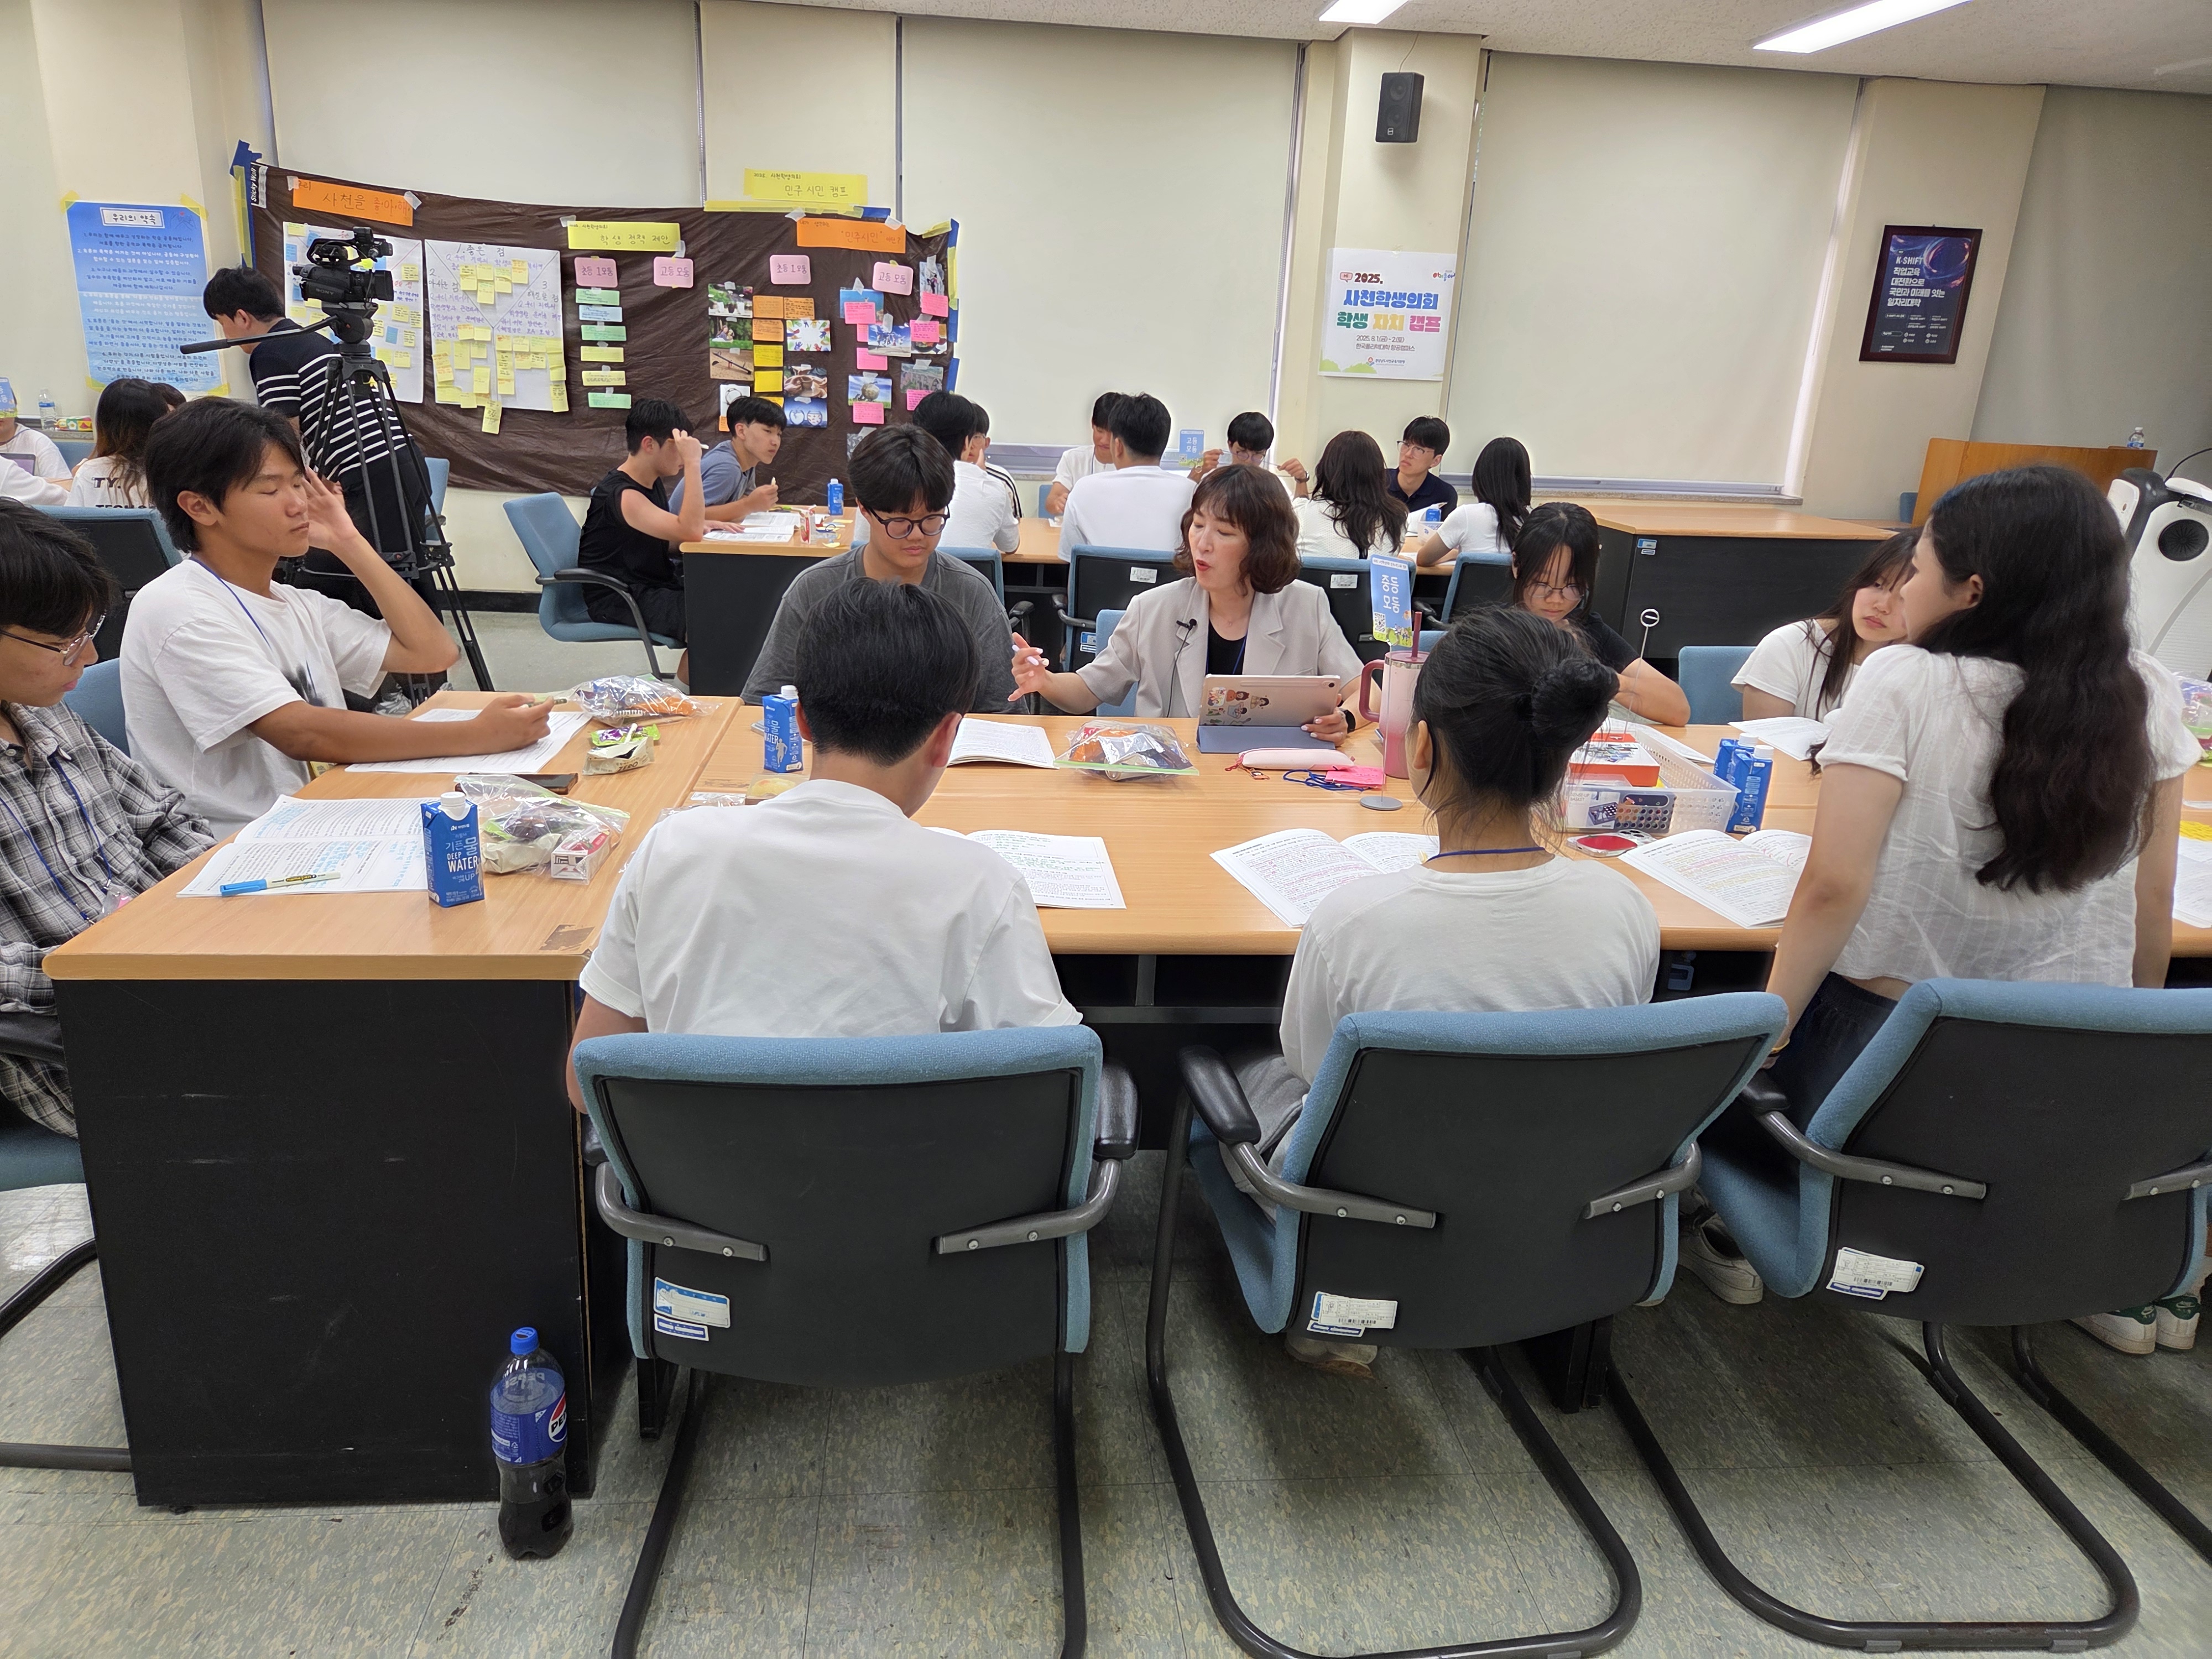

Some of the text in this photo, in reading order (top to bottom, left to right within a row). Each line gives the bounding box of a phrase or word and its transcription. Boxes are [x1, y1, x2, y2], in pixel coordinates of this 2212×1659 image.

[785, 185, 849, 197] 민주 시민 캠프
[322, 193, 366, 210] 사천을
[113, 213, 156, 225] 우리의 약속
[600, 234, 670, 246] 학생 정책 제안
[466, 245, 486, 256] 좋은
[497, 248, 505, 257] 점
[581, 266, 593, 276] 초등
[660, 266, 690, 278] 고등 모둠
[777, 263, 789, 274] 초등
[1893, 267, 1921, 276] 직업교육
[878, 272, 907, 284] 고등 모둠
[1354, 273, 1384, 284] 2025.
[1891, 278, 1925, 286] 대전환으로
[1889, 288, 1910, 296] 국민과
[1931, 289, 1945, 298] 잇는
[1343, 289, 1439, 310] 사천학생의회
[1887, 298, 1922, 307] 일자리대학
[1337, 311, 1442, 332] 학생 자치 캠프
[1186, 437, 1198, 445] 고등
[1381, 575, 1399, 594] 중등
[1383, 595, 1400, 614] 모둠
[618, 761, 639, 773] ZERO
[463, 836, 478, 856] 물
[447, 852, 462, 860] DEEP
[447, 855, 478, 873] WATER
